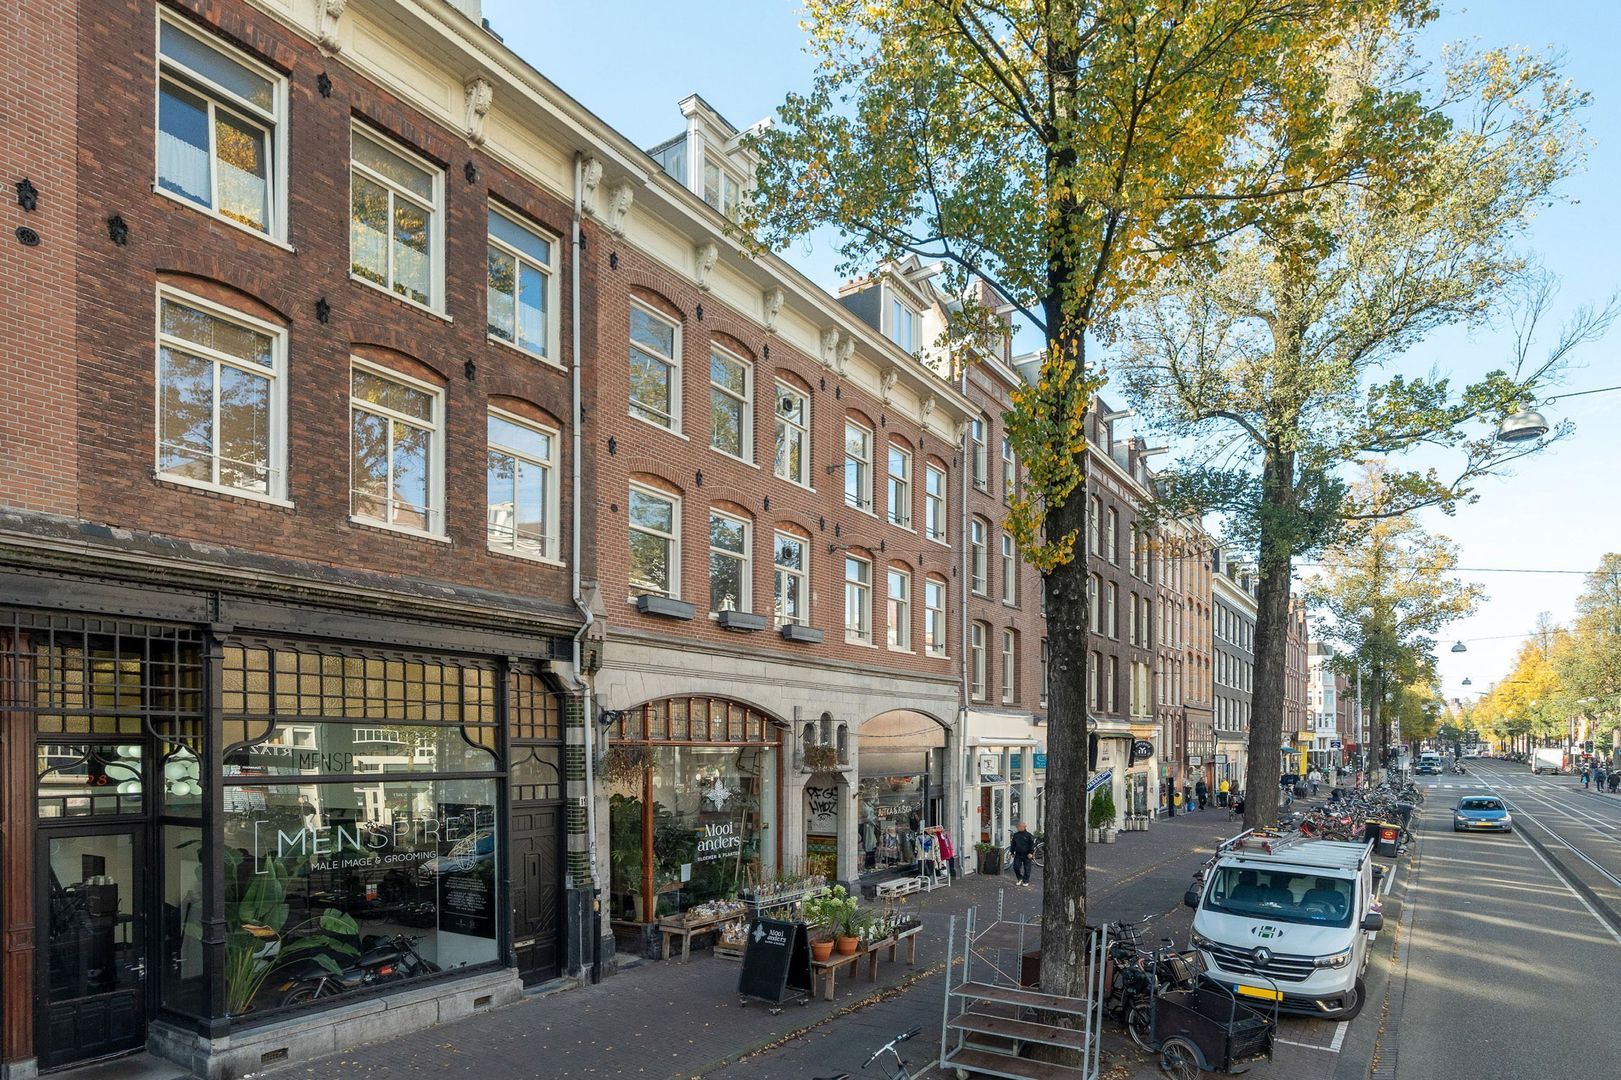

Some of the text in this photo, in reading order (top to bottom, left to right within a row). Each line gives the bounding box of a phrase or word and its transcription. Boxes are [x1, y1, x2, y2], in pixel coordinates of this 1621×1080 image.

[277, 816, 461, 858] MENSPIRE
[705, 821, 733, 837] Mooi
[697, 836, 741, 852] anders
[311, 850, 437, 871] MALE IMAGE & GROOMING
[769, 929, 784, 937] Mooi
